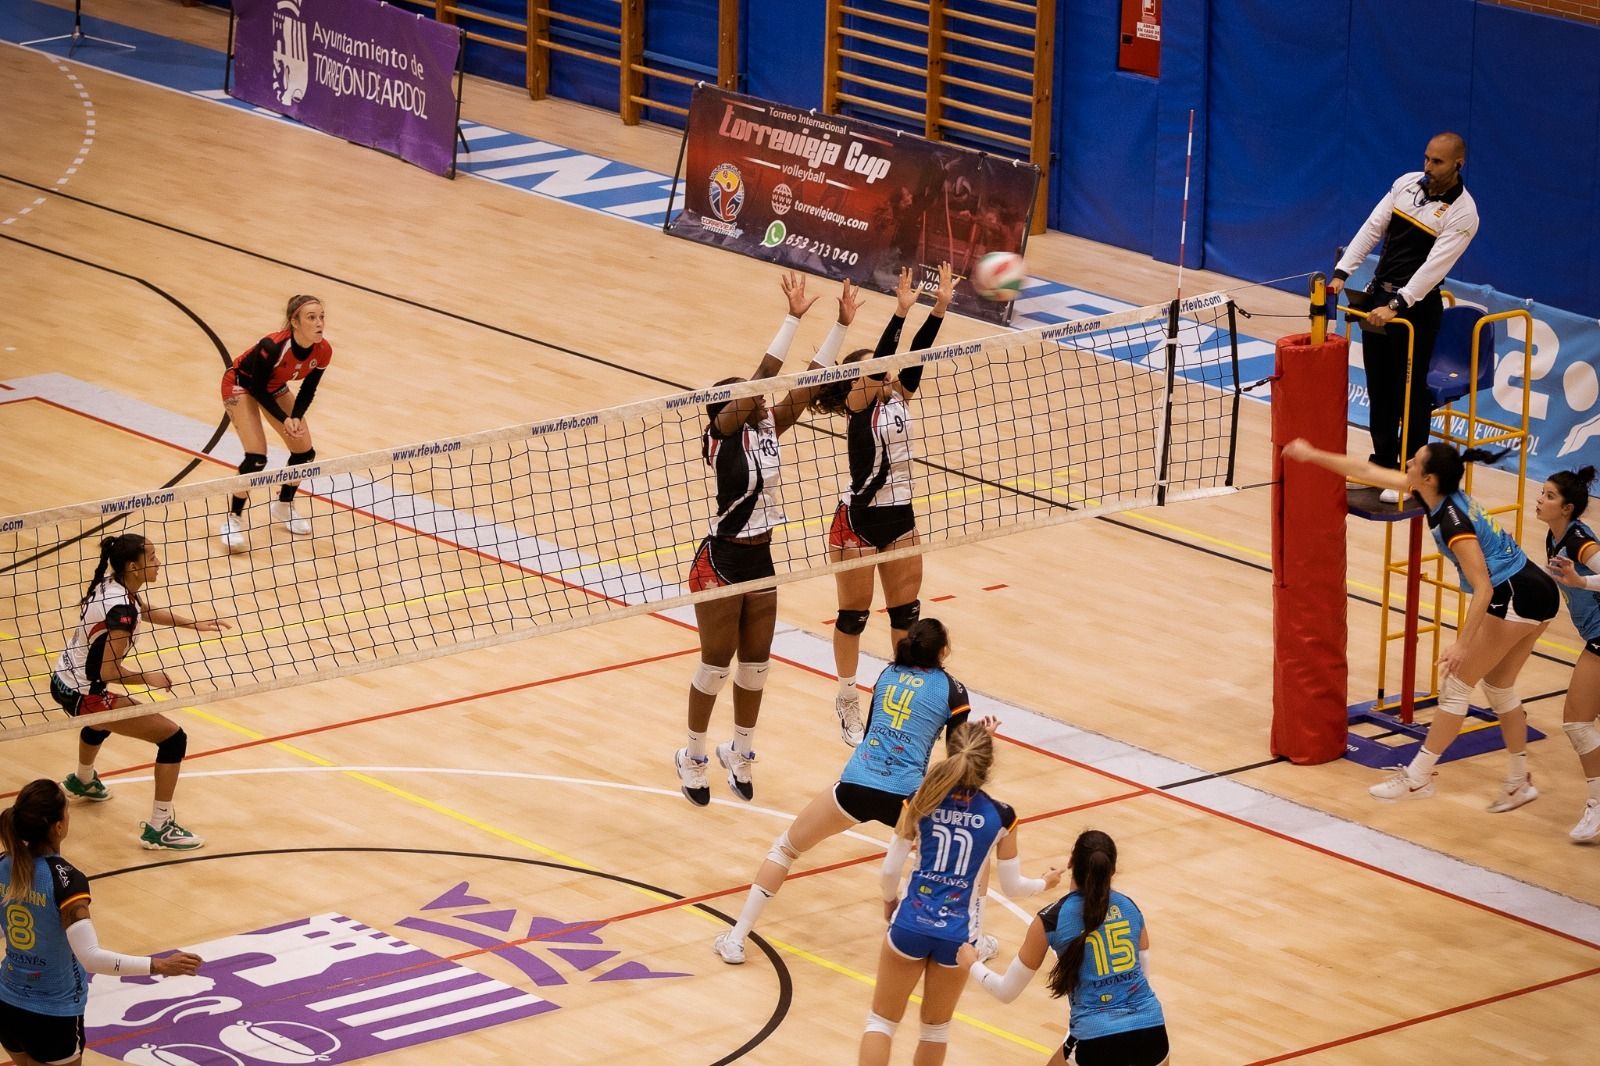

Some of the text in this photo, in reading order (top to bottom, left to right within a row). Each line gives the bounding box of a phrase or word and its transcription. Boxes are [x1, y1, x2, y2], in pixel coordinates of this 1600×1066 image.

[313, 21, 424, 80] Ayuntamiento de
[313, 52, 365, 98] TORREJÓN
[381, 78, 428, 120] ARDOZ
[769, 106, 847, 135] Torneo Internacional
[843, 141, 892, 184] Cup
[782, 164, 826, 184] volleyball
[794, 200, 869, 231] torreviejacup.com
[785, 233, 859, 266] 653 213 040
[1041, 320, 1101, 340] www.rfevb.com
[920, 342, 982, 362] www.rfevb.com
[797, 366, 860, 386] www.rfevb.com
[665, 389, 731, 409] www.rfevb.com
[532, 414, 598, 435] www.rfevb.com
[894, 414, 904, 434] 9
[392, 440, 461, 461] www.rfevb.com
[759, 438, 778, 457] 10
[250, 466, 321, 487] www.rfevb.com
[101, 492, 175, 514] www.rfevb.com
[898, 672, 925, 688] VIO
[881, 684, 915, 730] 4
[930, 808, 985, 829] CURTO
[931, 824, 974, 876] 11
[6, 903, 36, 950] 8
[1080, 919, 1137, 977] 15
